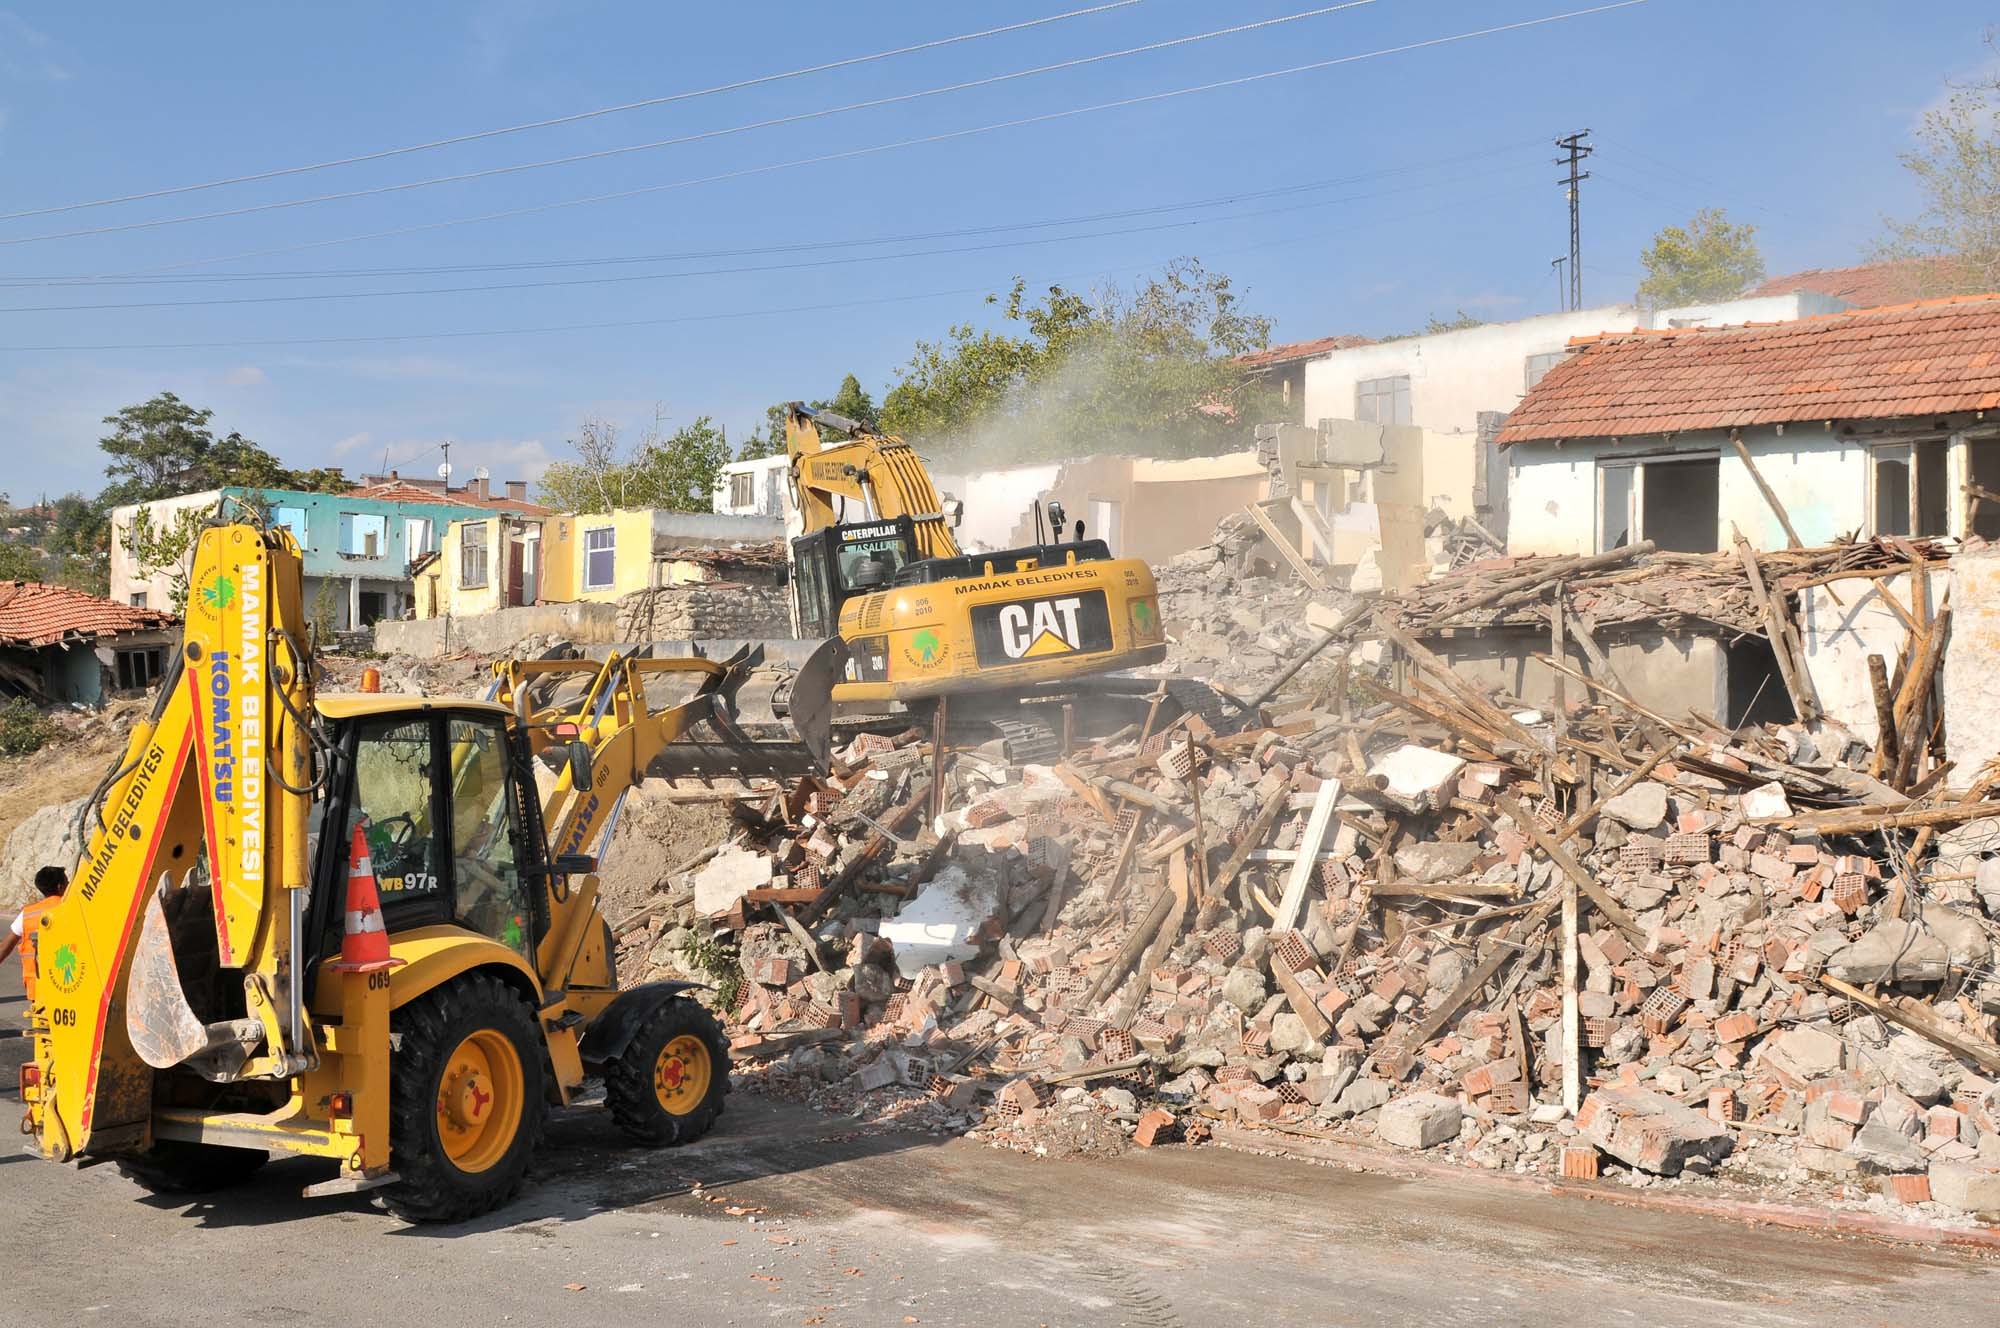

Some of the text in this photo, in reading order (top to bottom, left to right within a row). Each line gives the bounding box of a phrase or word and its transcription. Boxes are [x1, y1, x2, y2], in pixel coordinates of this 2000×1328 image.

[842, 525, 897, 541] CATERPILLAR
[955, 579, 1012, 595] MAMAK
[915, 598, 929, 606] 006
[915, 606, 933, 616] 2010
[242, 565, 260, 684] MAMAK
[1000, 597, 1081, 659] CAT
[211, 651, 237, 802] KOMATSU
[596, 764, 610, 788] 069
[81, 838, 118, 901] MAMAK
[369, 970, 390, 991] 069
[53, 1007, 76, 1027] 069
